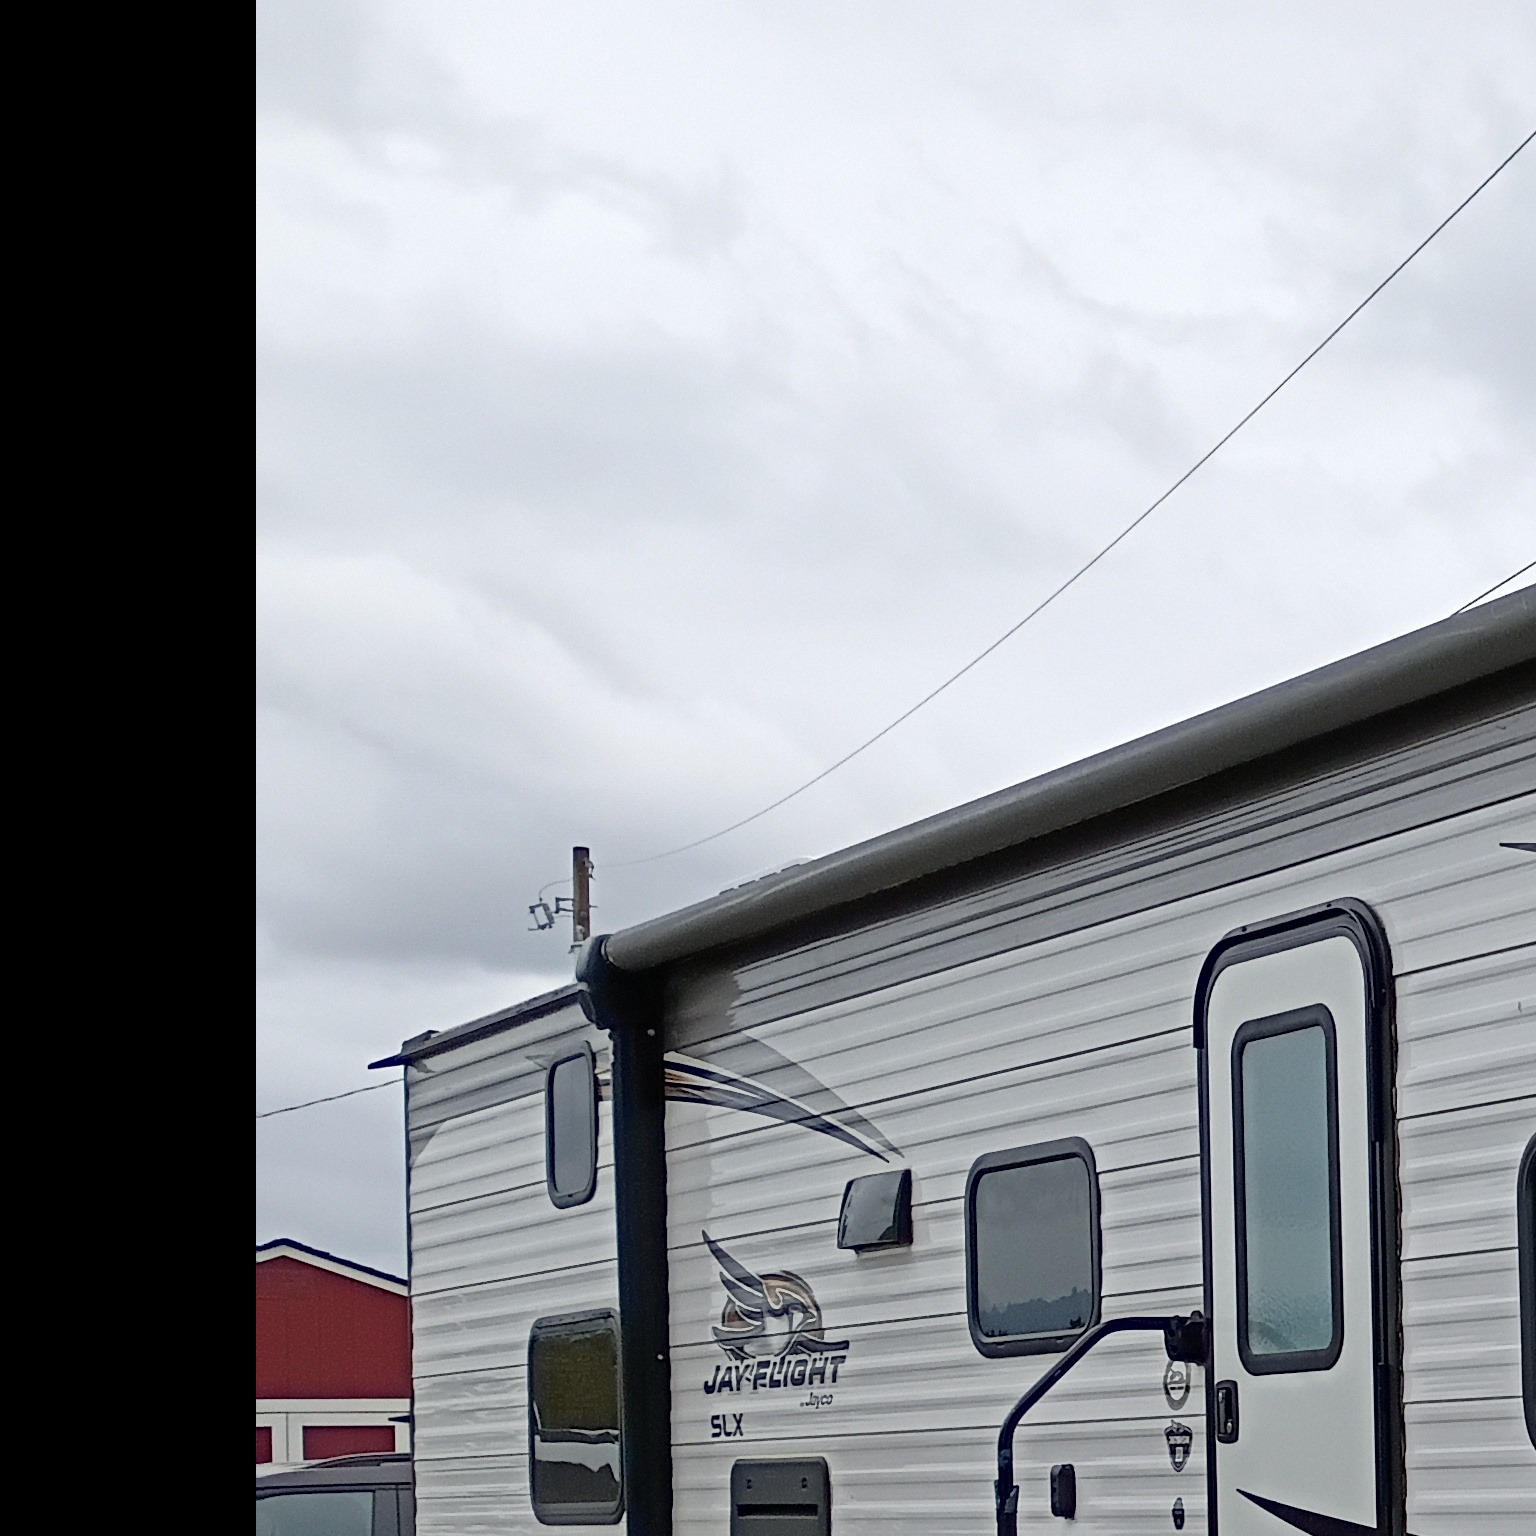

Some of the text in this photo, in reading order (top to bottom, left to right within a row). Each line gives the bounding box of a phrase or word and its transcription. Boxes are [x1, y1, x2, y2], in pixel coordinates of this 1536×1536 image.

[704, 1355, 847, 1394] JAY FLIGHT
[710, 1413, 744, 1438] SLX
